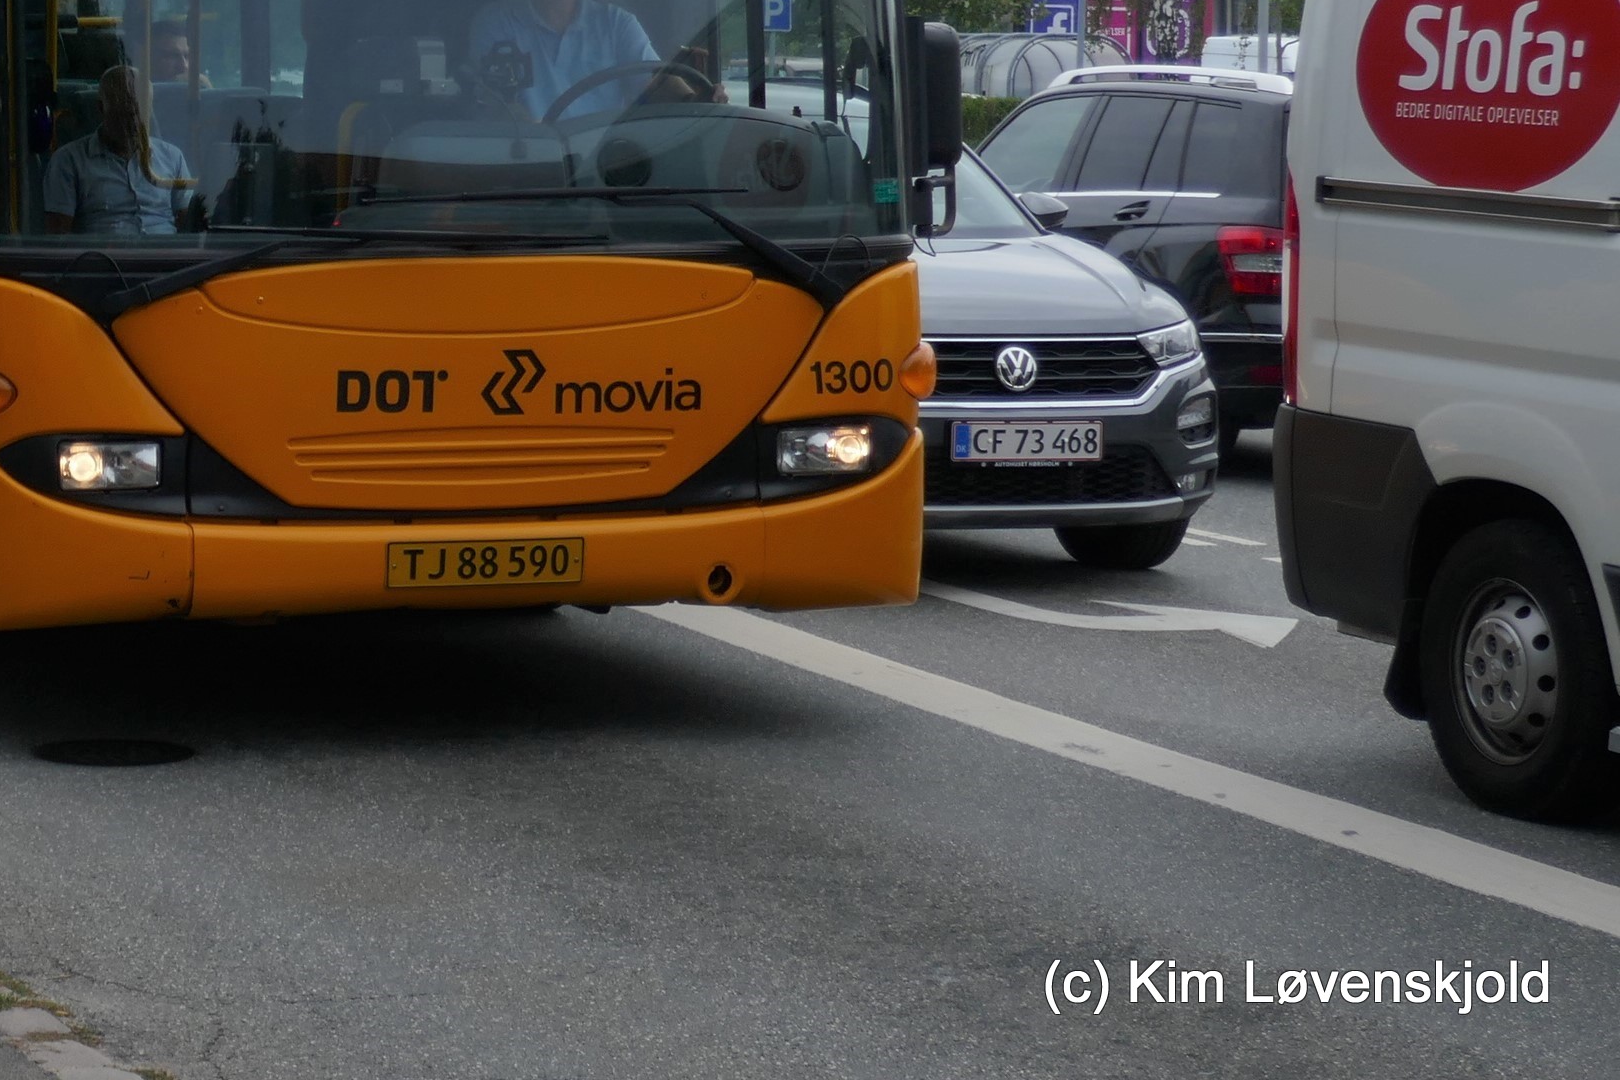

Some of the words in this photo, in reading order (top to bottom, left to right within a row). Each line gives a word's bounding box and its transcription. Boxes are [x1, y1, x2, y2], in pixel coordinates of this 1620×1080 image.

[1396, 102, 1431, 119] BEDRE
[1434, 104, 1484, 122] DIGITALE
[1487, 106, 1559, 126] OPLEVELSER
[554, 368, 701, 413] movia
[810, 358, 893, 395] 1300
[973, 429, 1006, 454] CF
[1015, 429, 1044, 454] 73
[1052, 428, 1098, 454] 468
[457, 547, 499, 579] 88
[507, 544, 570, 576] 590
